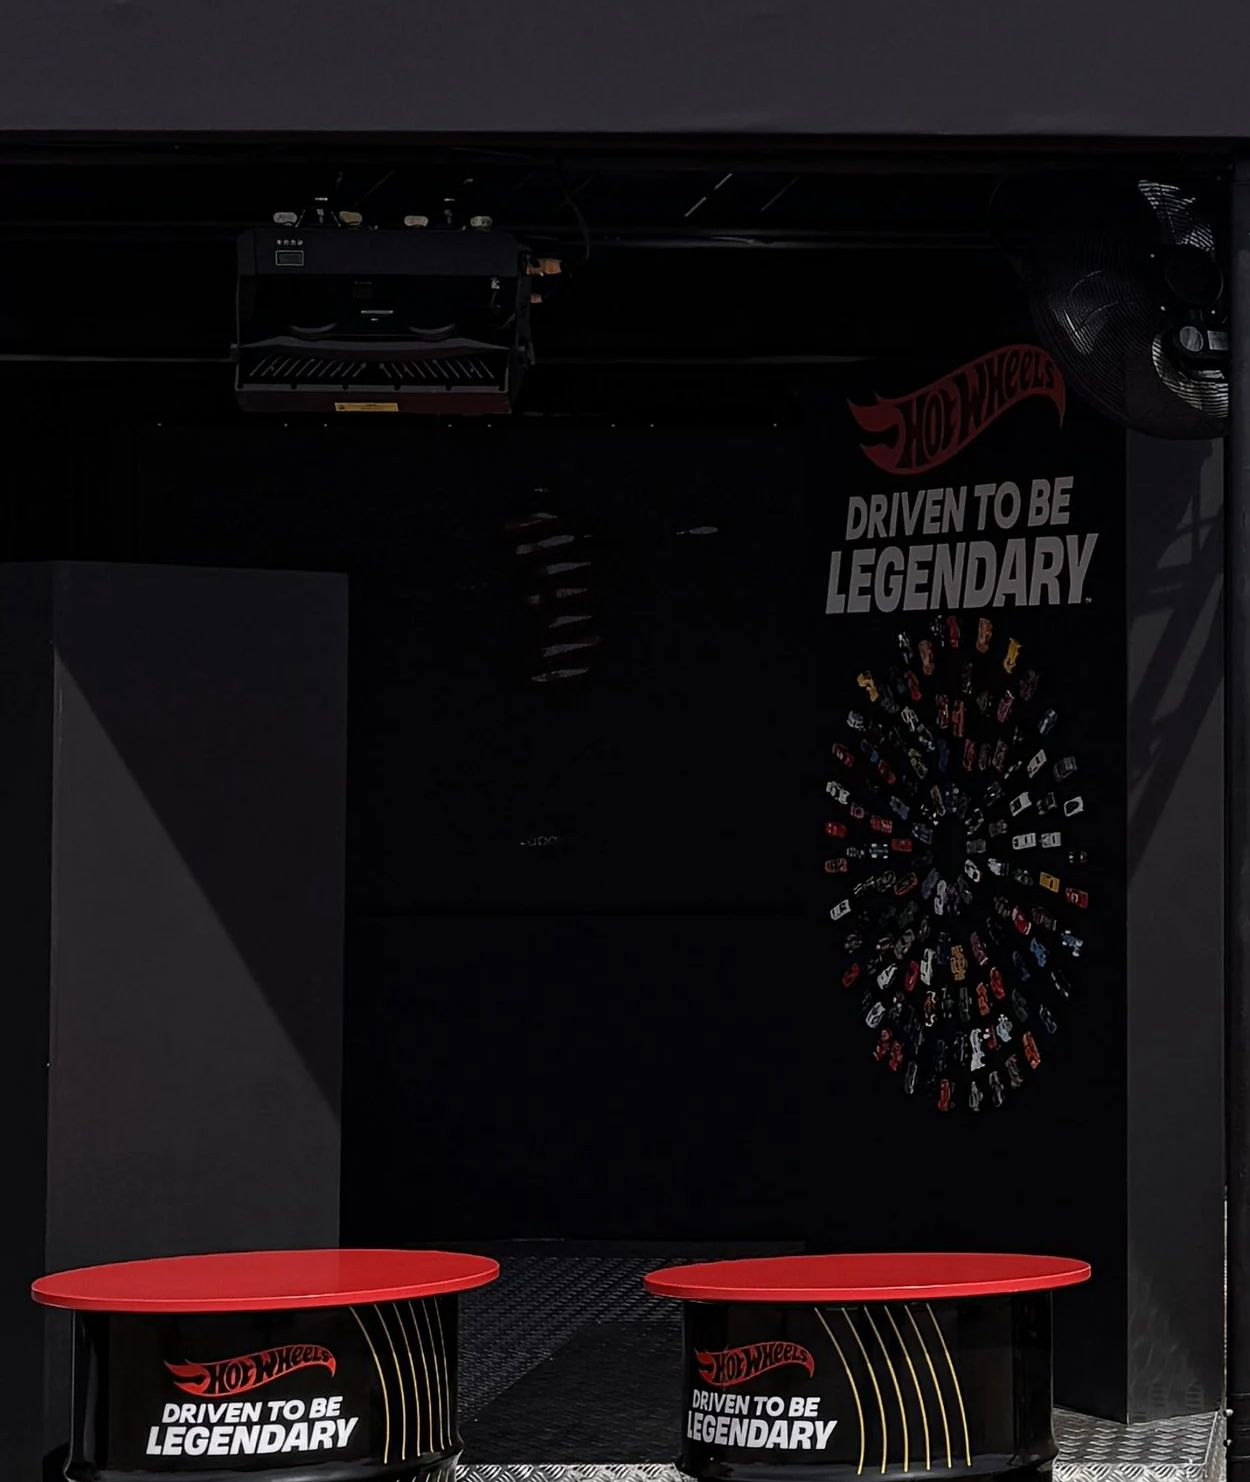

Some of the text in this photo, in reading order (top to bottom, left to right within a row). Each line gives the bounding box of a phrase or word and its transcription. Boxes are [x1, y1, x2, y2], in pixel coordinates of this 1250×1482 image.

[846, 477, 1074, 540] DRIVEN TO BE
[209, 1360, 257, 1394] HOT
[713, 1351, 745, 1383] HOT
[162, 1397, 343, 1424] DRIVEN TO BE
[692, 1389, 821, 1418] DRIVEN TO BE
[146, 1418, 359, 1455] LEGENDARY
[687, 1410, 838, 1450] LEGENDARY
